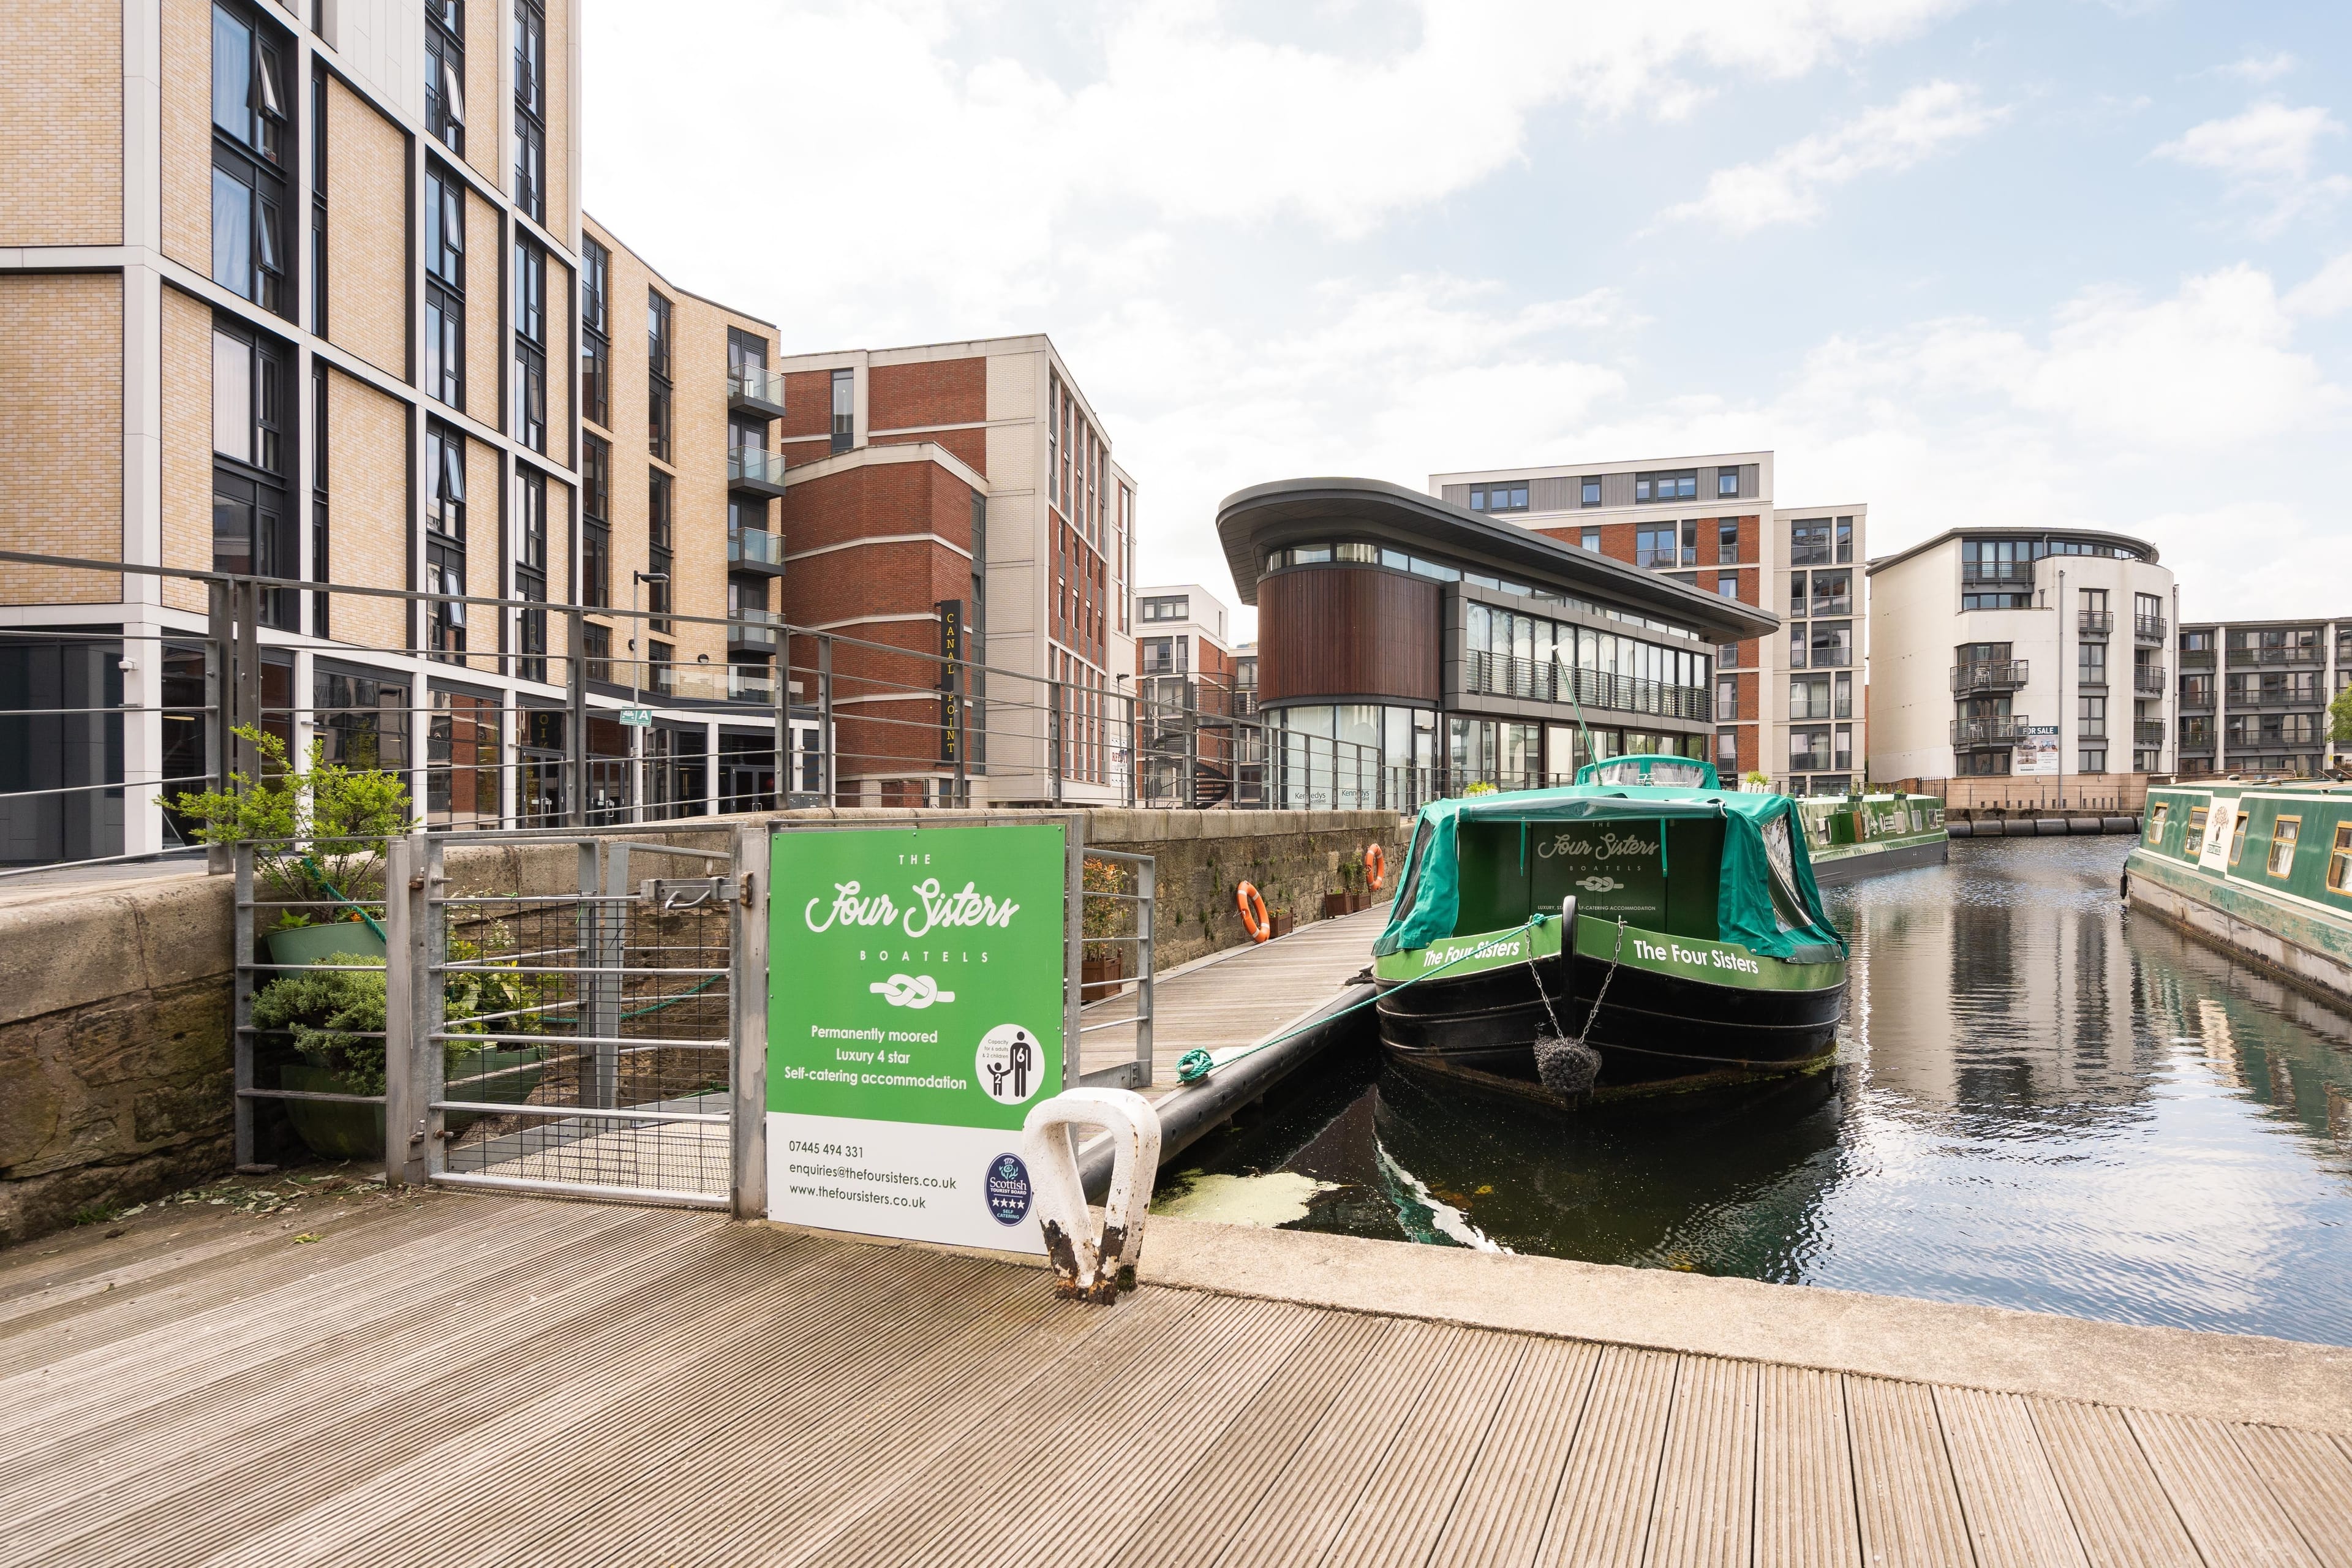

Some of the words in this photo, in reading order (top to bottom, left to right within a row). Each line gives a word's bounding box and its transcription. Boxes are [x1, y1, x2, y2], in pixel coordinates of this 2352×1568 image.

[638, 710, 649, 720] A
[1537, 834, 1592, 858] Four
[1595, 833, 1659, 860] Sisters
[899, 854, 931, 865] THE
[805, 881, 899, 933] Four
[903, 878, 1020, 938] Sisters
[860, 950, 988, 962] BOATELS
[1423, 950, 1443, 967] The
[1444, 946, 1474, 963] Four
[1474, 940, 1520, 959] Sisters
[1634, 940, 1667, 961] The
[1671, 944, 1707, 966] Four
[1711, 949, 1759, 974] Sisters
[811, 1025, 885, 1043] Permanently
[888, 1030, 938, 1042] moored
[836, 1048, 875, 1065] Luxury
[877, 1050, 885, 1063] 4
[888, 1051, 911, 1064] star
[1016, 1047, 1025, 1063] 6
[785, 1066, 858, 1085] Self-catering
[861, 1074, 967, 1090] accommodation
[994, 1073, 1001, 1084] 2
[789, 1140, 820, 1154] 07445
[823, 1144, 842, 1156] 494
[845, 1145, 863, 1158] 331
[789, 1163, 957, 1189] enquiries@thefoursisters.co.uk
[990, 1177, 1027, 1191] Scottish
[789, 1185, 926, 1208] www.thefoursisters.co.uk
